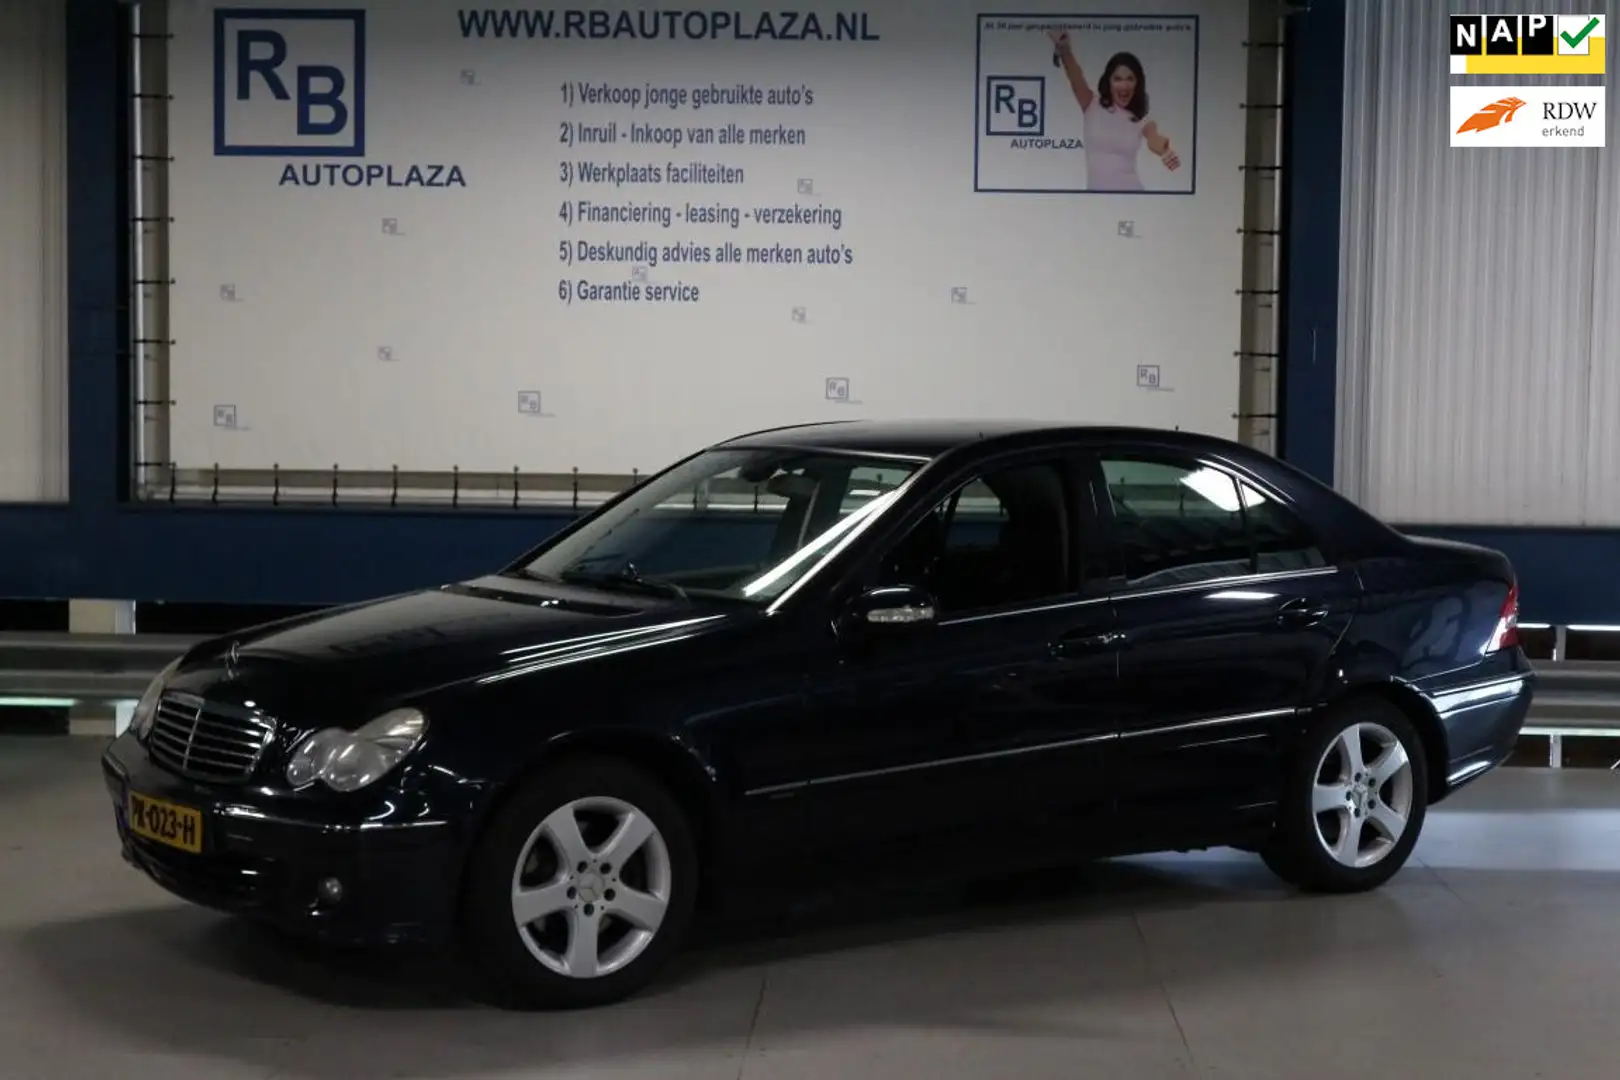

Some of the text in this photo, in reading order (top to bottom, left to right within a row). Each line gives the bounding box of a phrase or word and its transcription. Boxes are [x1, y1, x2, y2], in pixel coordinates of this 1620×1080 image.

[458, 9, 880, 41] WWW.RBAUTOPLAZA.NL
[560, 82, 814, 110] 1) Verkoop jonge gebruikte auto's
[559, 122, 574, 147] 2)
[577, 122, 618, 143] Inruil
[630, 123, 683, 148] Inkoop
[686, 127, 714, 144] van
[718, 124, 745, 145] alle
[749, 124, 806, 145] merken
[1009, 138, 1084, 150] AUTOPLAZA
[278, 163, 467, 188] AUTOPLAZA
[559, 161, 744, 188] 3) Werkplaats faciliteiten
[559, 201, 573, 226] 4)
[577, 200, 672, 228] Financiering
[684, 202, 740, 229] leasing
[753, 203, 843, 231] verzekering
[558, 240, 854, 267] 5) Deskundig advies alle merken auto's
[557, 279, 700, 304] 6) Garantie service
